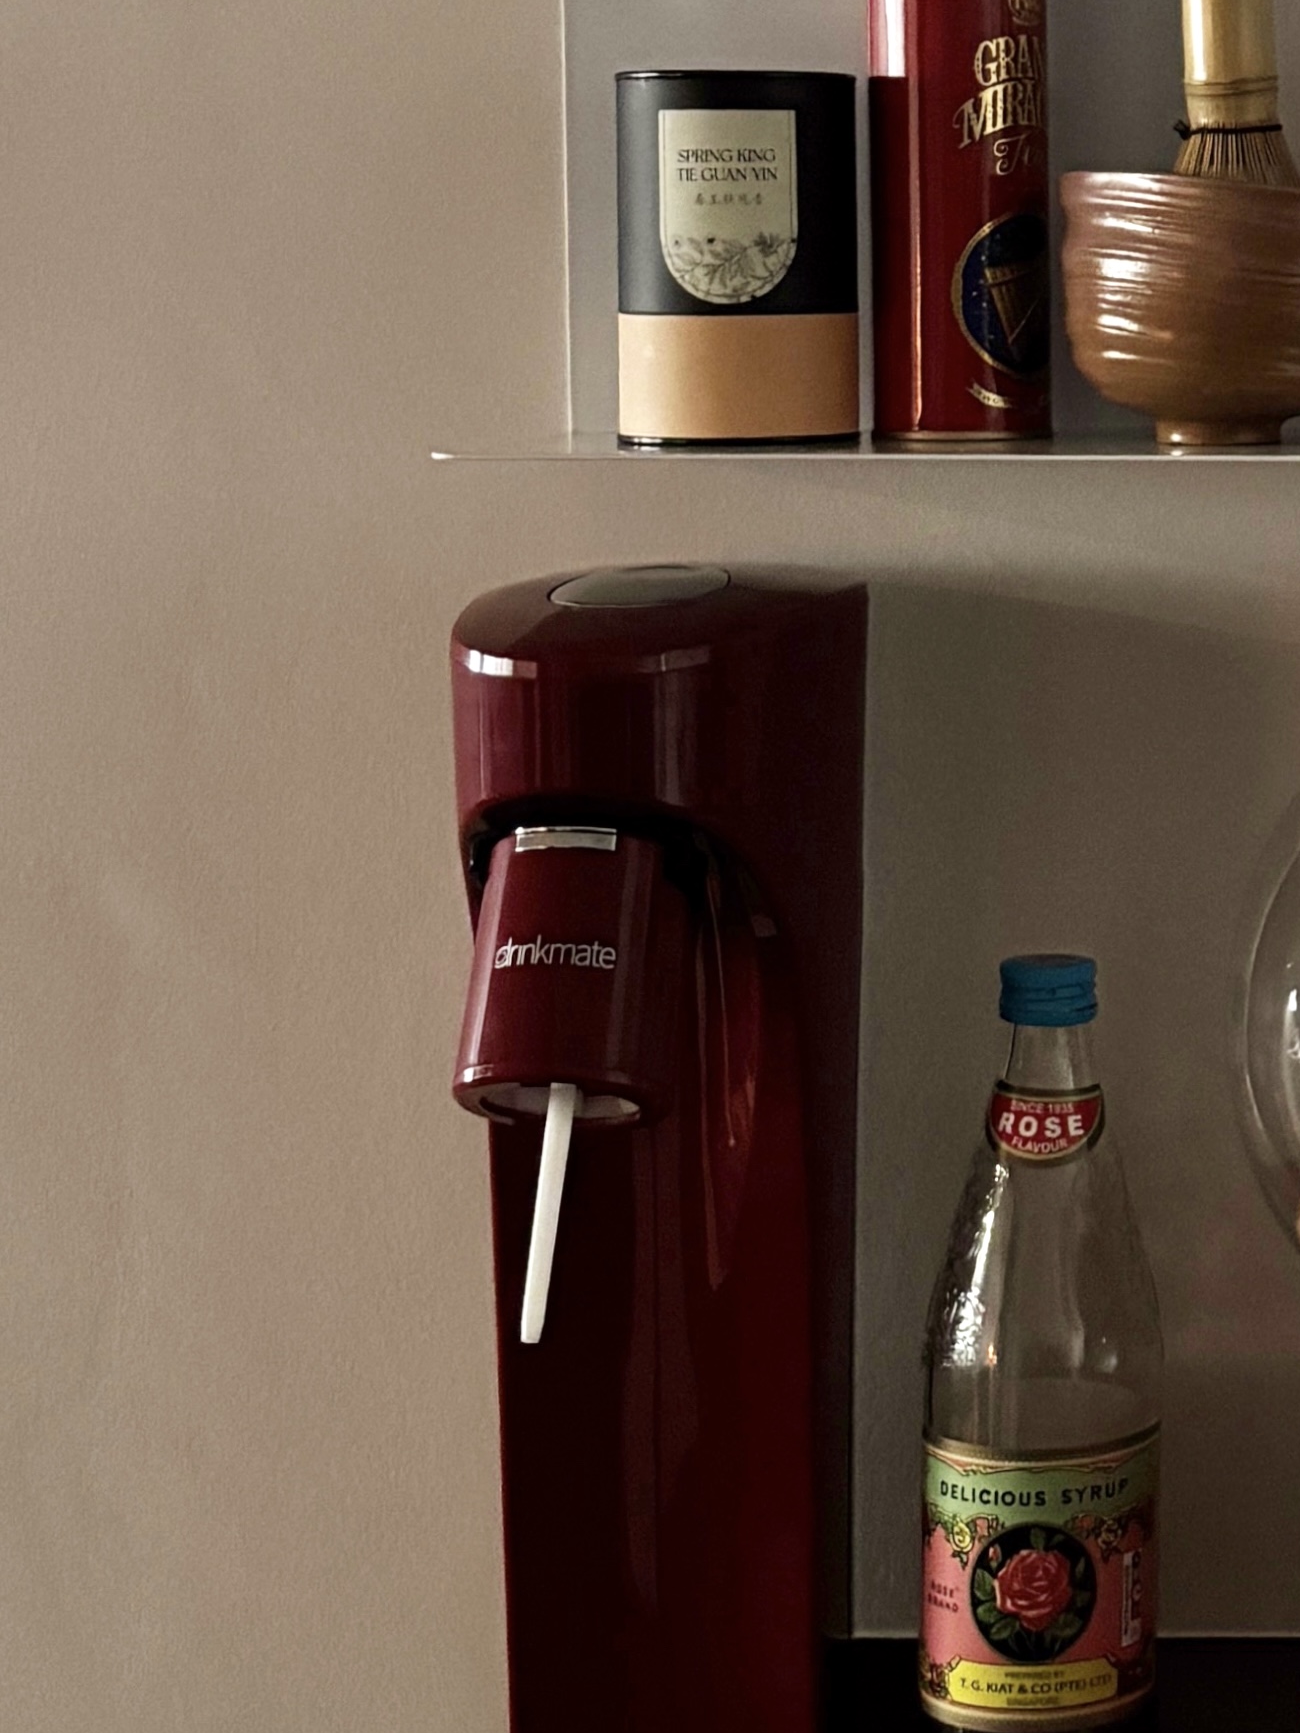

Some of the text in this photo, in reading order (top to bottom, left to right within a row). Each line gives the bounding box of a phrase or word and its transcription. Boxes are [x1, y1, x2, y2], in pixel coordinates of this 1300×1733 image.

[677, 148, 776, 163] SPRING KING
[677, 167, 778, 182] TIE GUAN YIN
[494, 934, 617, 969] drinkmate
[1010, 1099, 1045, 1114] SINCE
[997, 1111, 1085, 1138] ROSE
[1011, 1135, 1069, 1154] FLAVOUR
[940, 1477, 1129, 1507] DELICIOUS SYRUP
[986, 1682, 1013, 1695] KIAT
[1018, 1683, 1029, 1695] &
[1031, 1682, 1051, 1695] CO
